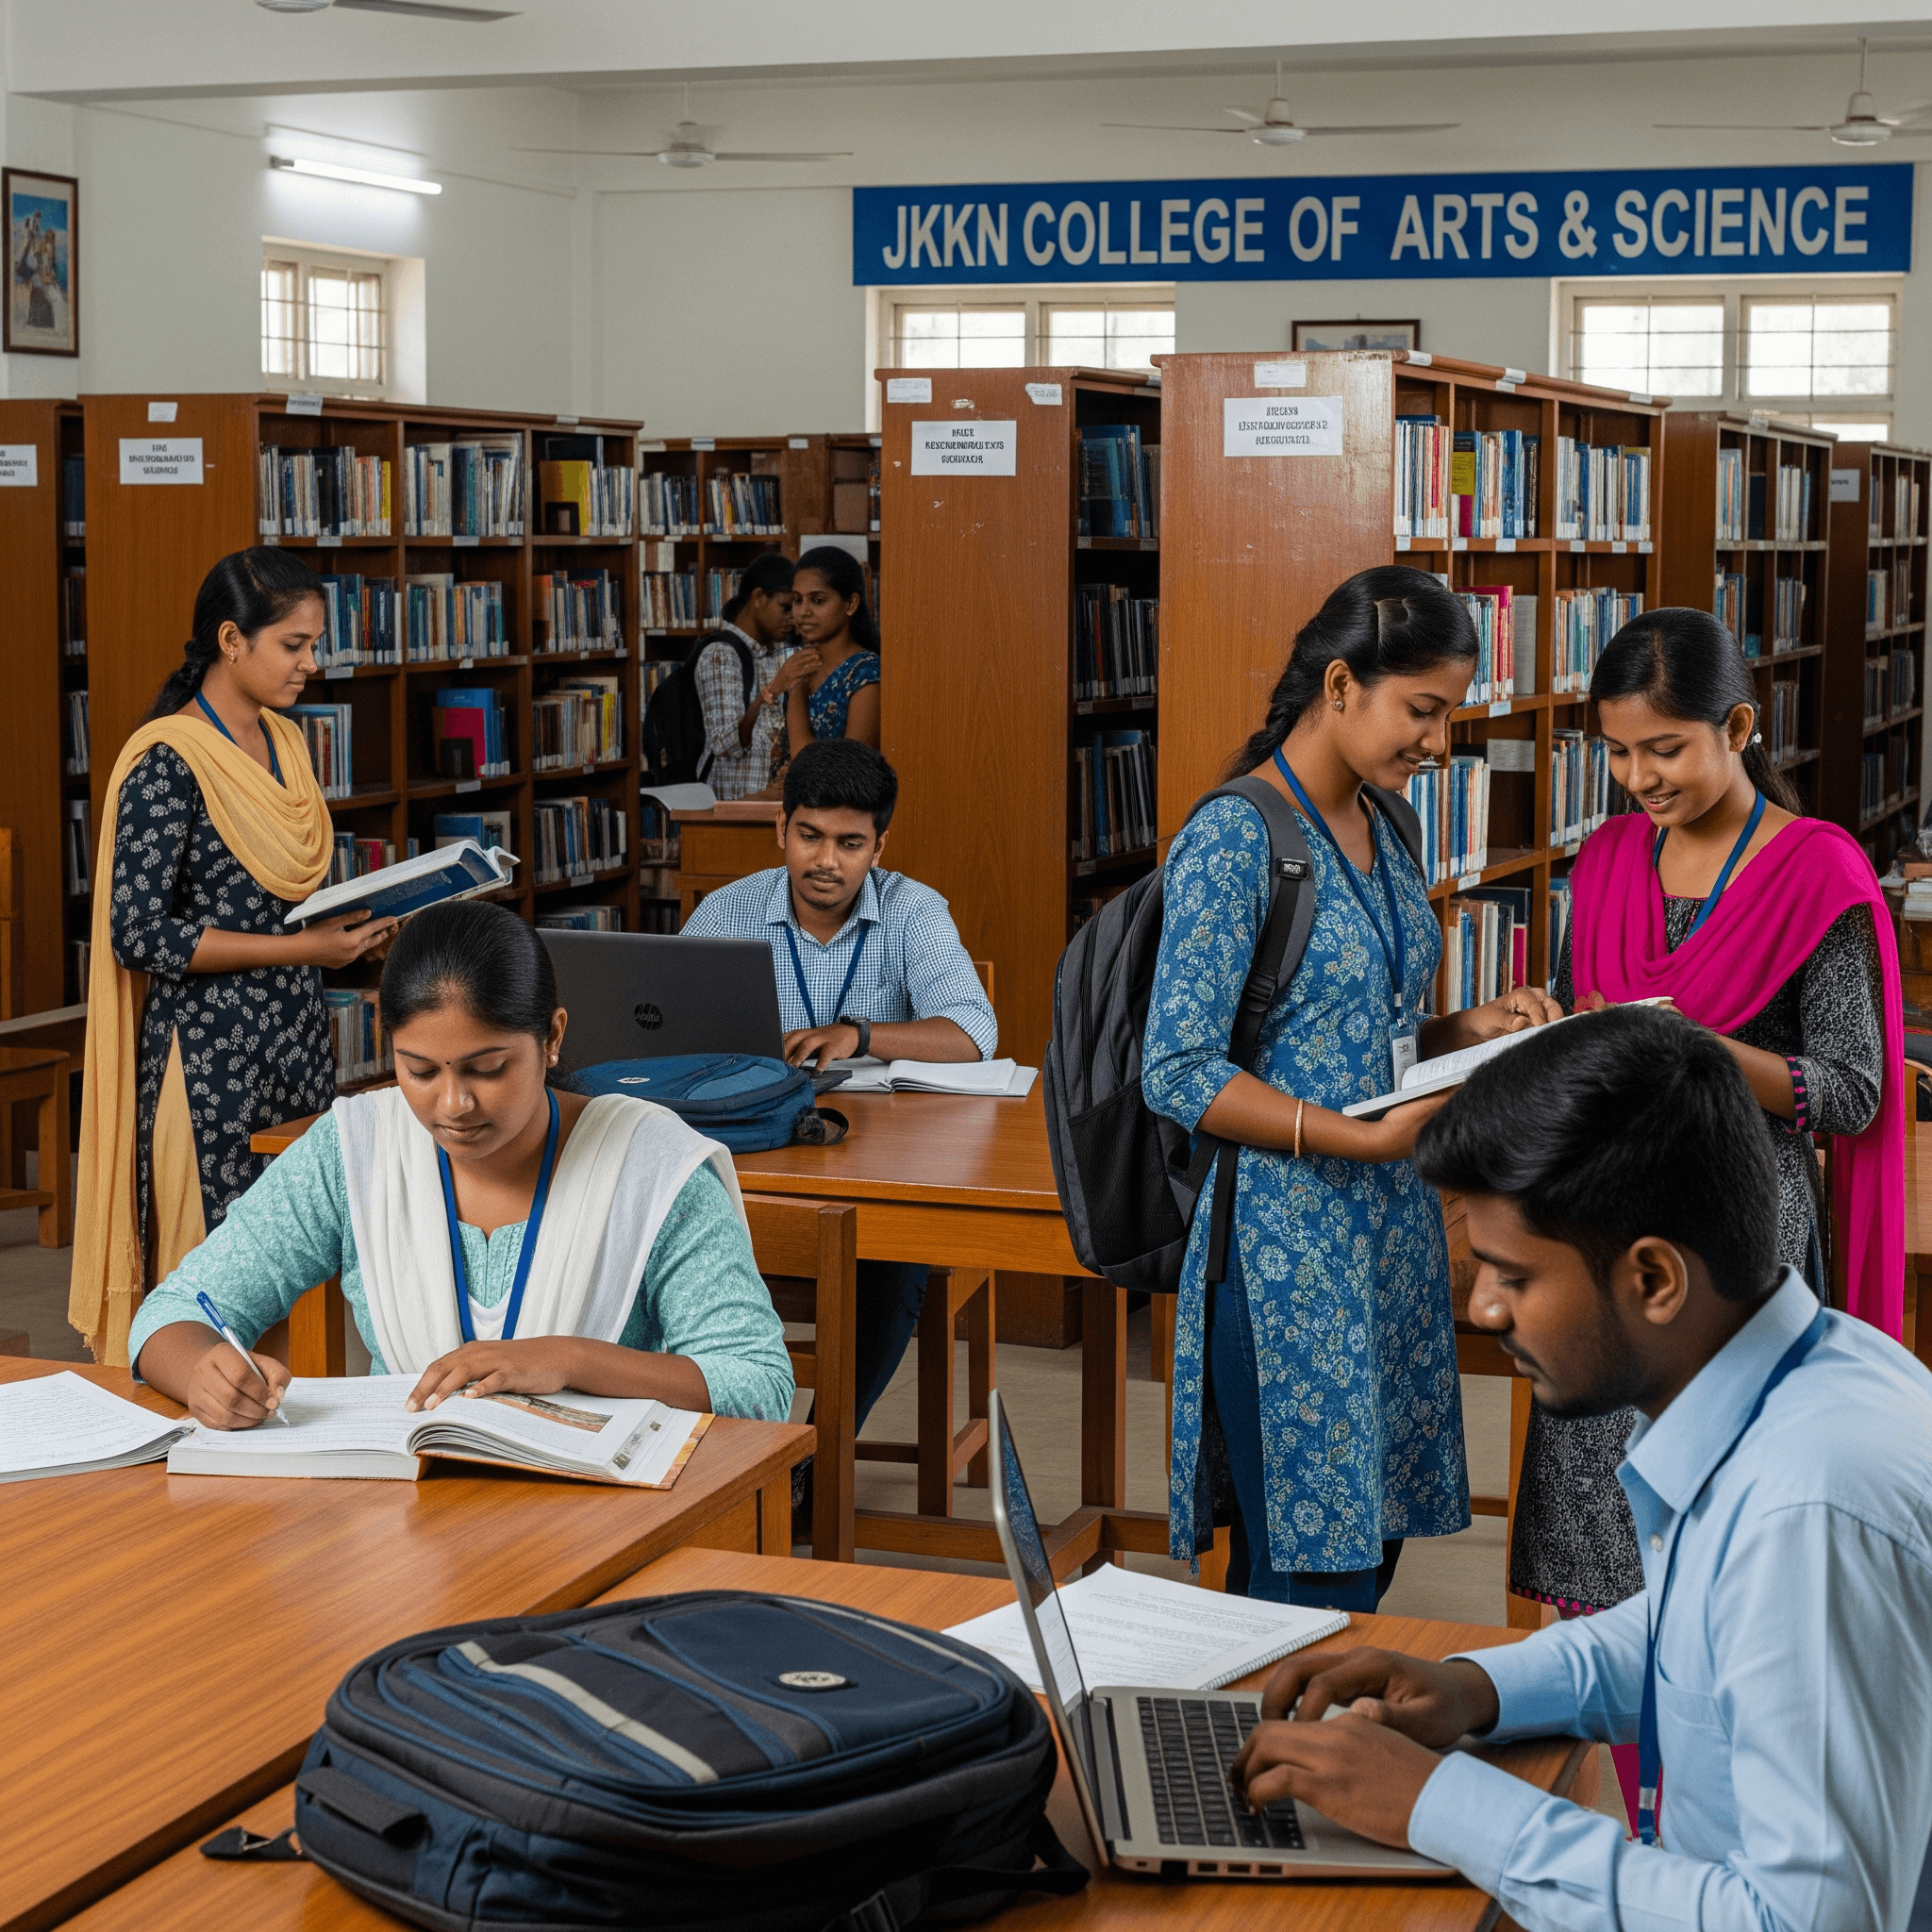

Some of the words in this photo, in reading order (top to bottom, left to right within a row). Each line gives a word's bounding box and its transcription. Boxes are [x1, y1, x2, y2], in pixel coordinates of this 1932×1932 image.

[883, 204, 1008, 268] JKKN
[1024, 199, 1263, 266] COLLEGE
[1290, 197, 1359, 261] OF
[1391, 192, 1538, 259] ARTS
[1559, 191, 1596, 258] &
[1613, 187, 1868, 258] SCIENCE
